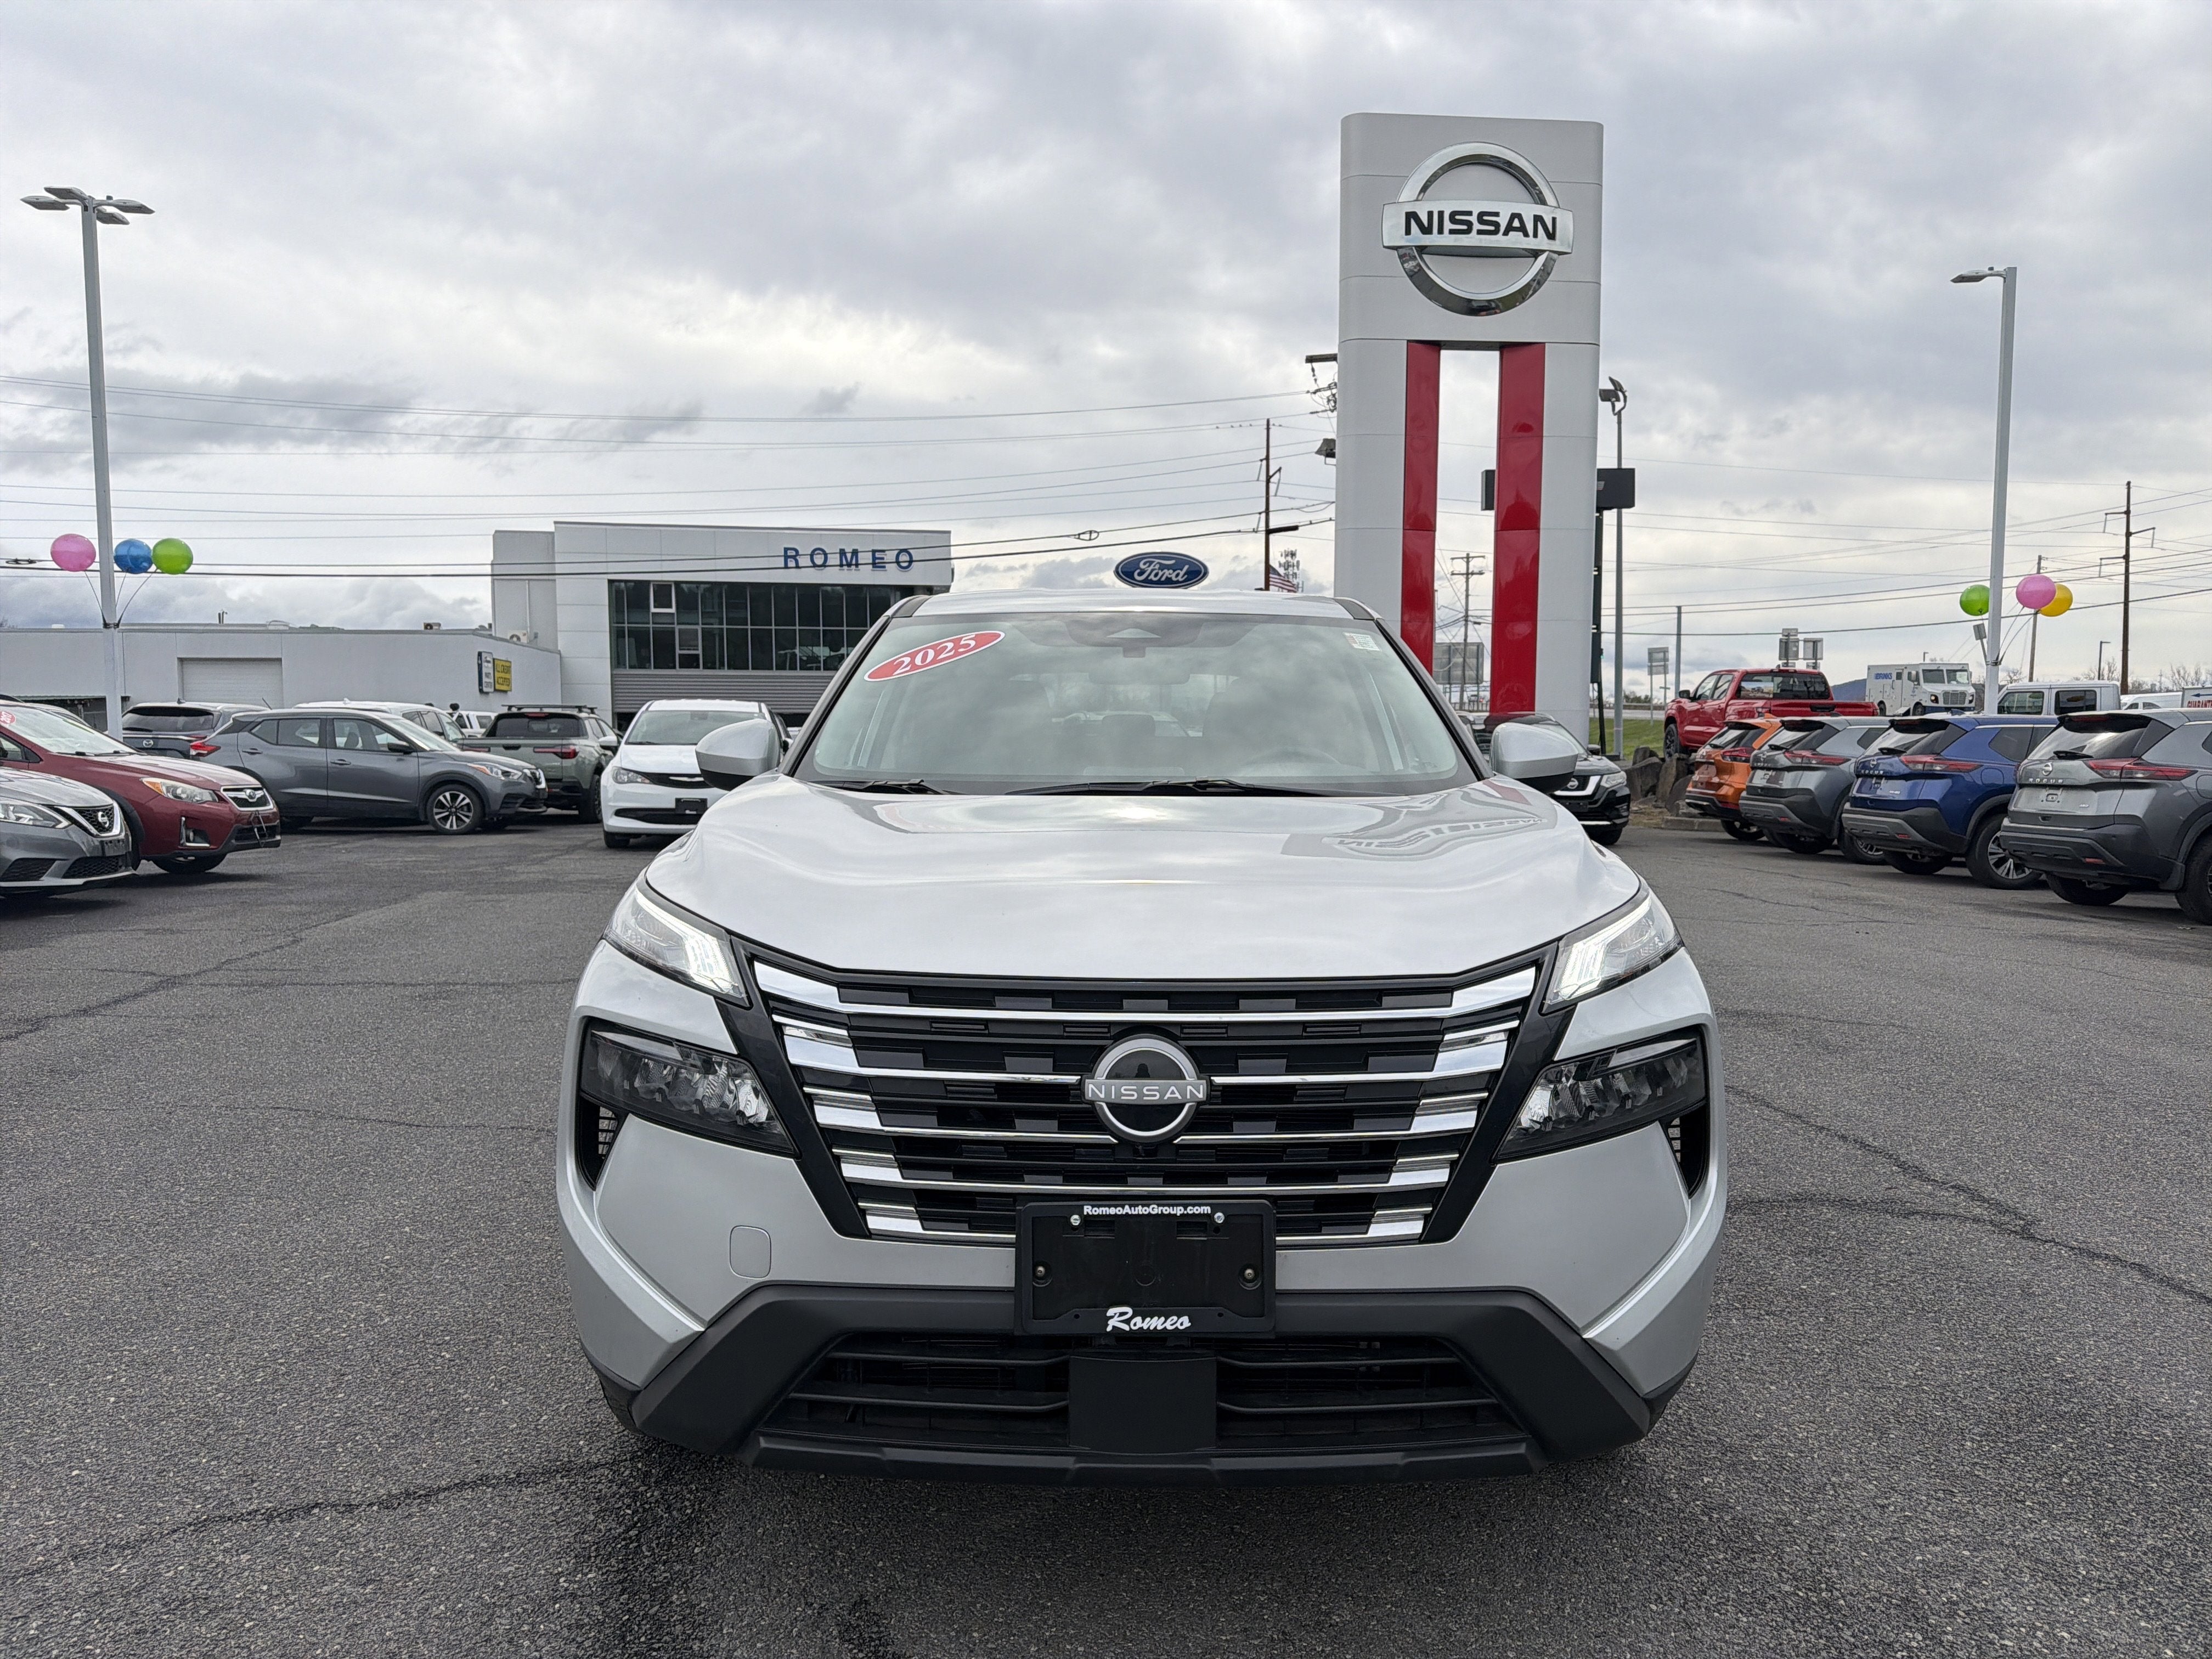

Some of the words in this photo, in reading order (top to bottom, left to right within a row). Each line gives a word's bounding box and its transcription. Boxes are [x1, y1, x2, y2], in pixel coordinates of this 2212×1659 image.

[1404, 210, 1558, 241] NISSAN
[783, 546, 913, 570] ROMEO
[1133, 558, 1190, 582] Ford
[892, 634, 977, 676] 2025
[1088, 1084, 1204, 1100] NISSAN
[1083, 1204, 1211, 1216] RomeoAutoGroup.com
[1106, 1306, 1192, 1332] Romeo
